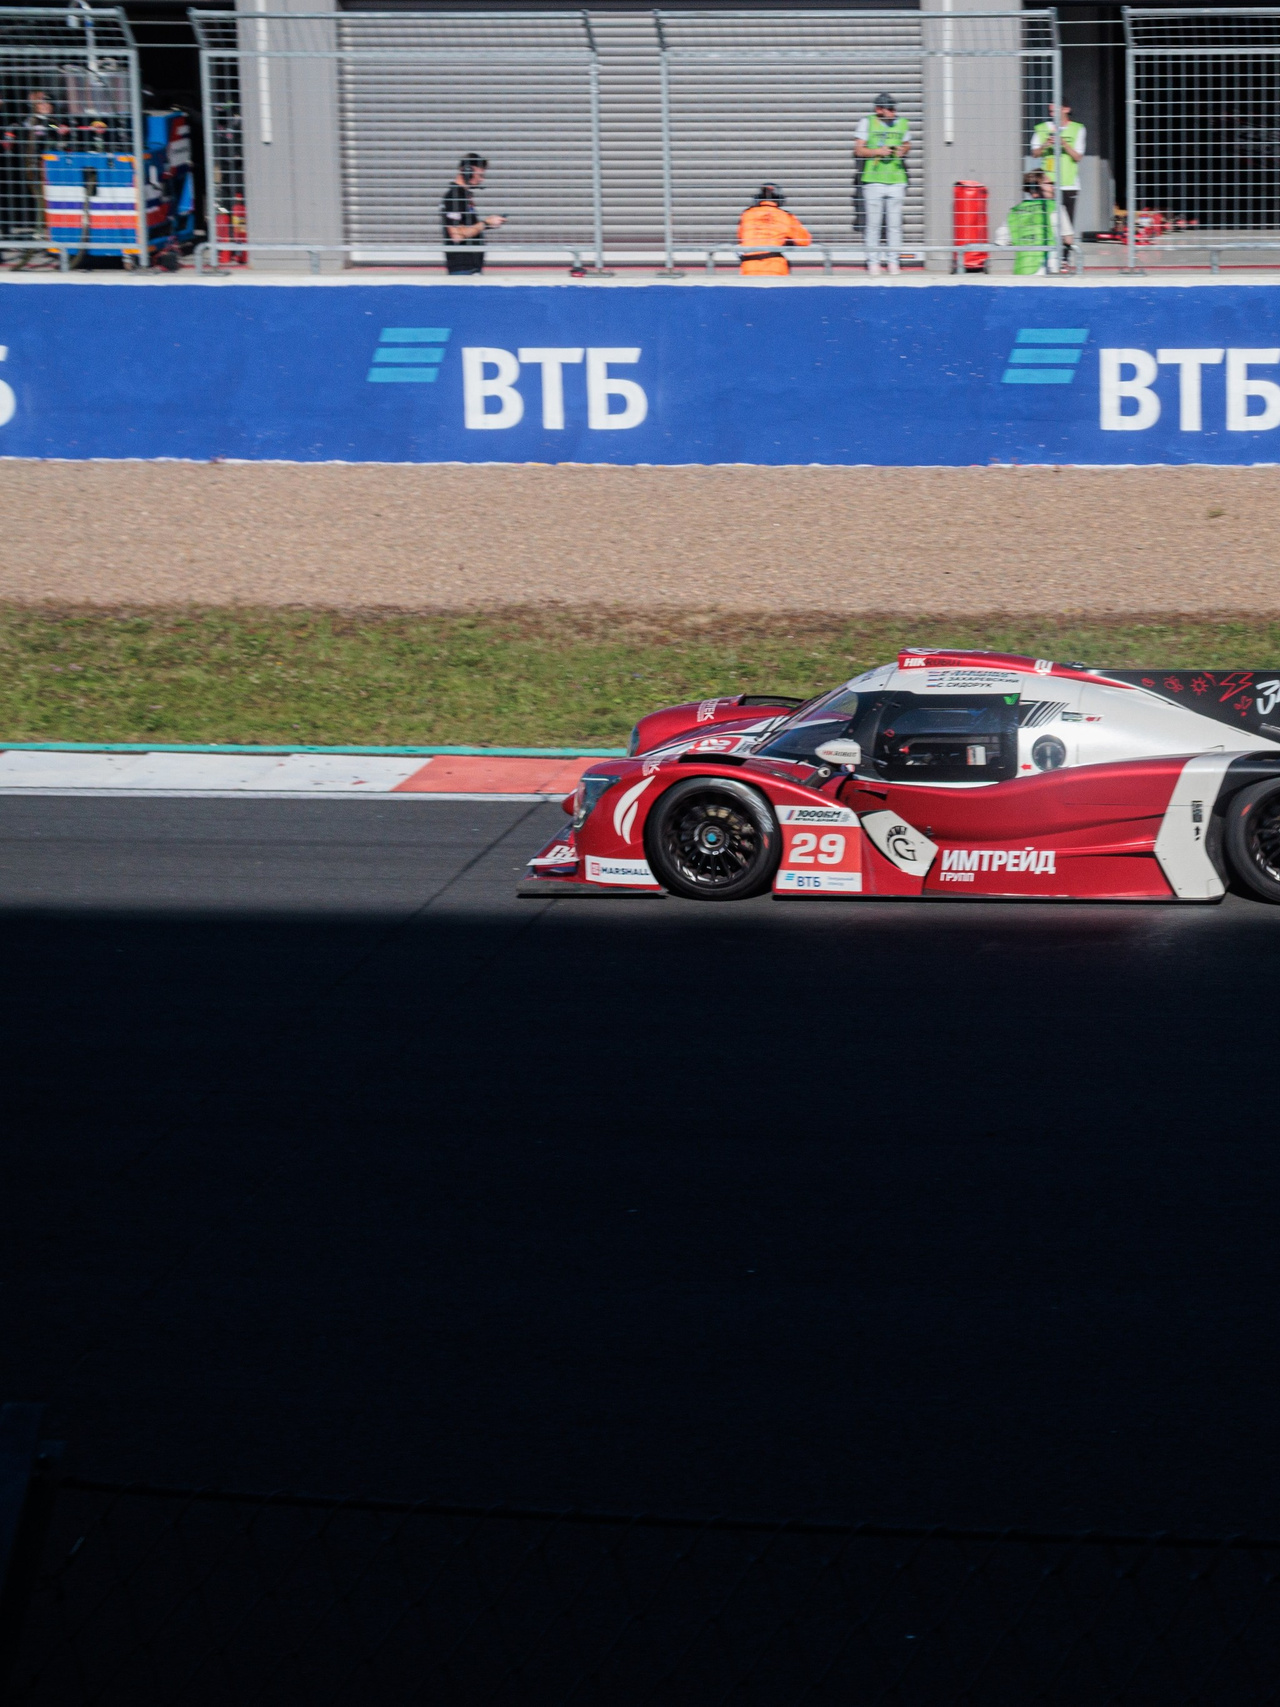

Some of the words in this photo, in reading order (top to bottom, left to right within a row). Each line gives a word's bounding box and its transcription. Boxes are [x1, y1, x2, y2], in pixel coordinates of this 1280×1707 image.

[462, 346, 648, 430] ВТБ
[788, 832, 846, 864] 29
[940, 847, 1056, 875] ИМТРЕЙД
[601, 867, 650, 876] MARSHALL
[939, 873, 974, 882] ГРУПП
[797, 876, 821, 887] ВТБ
